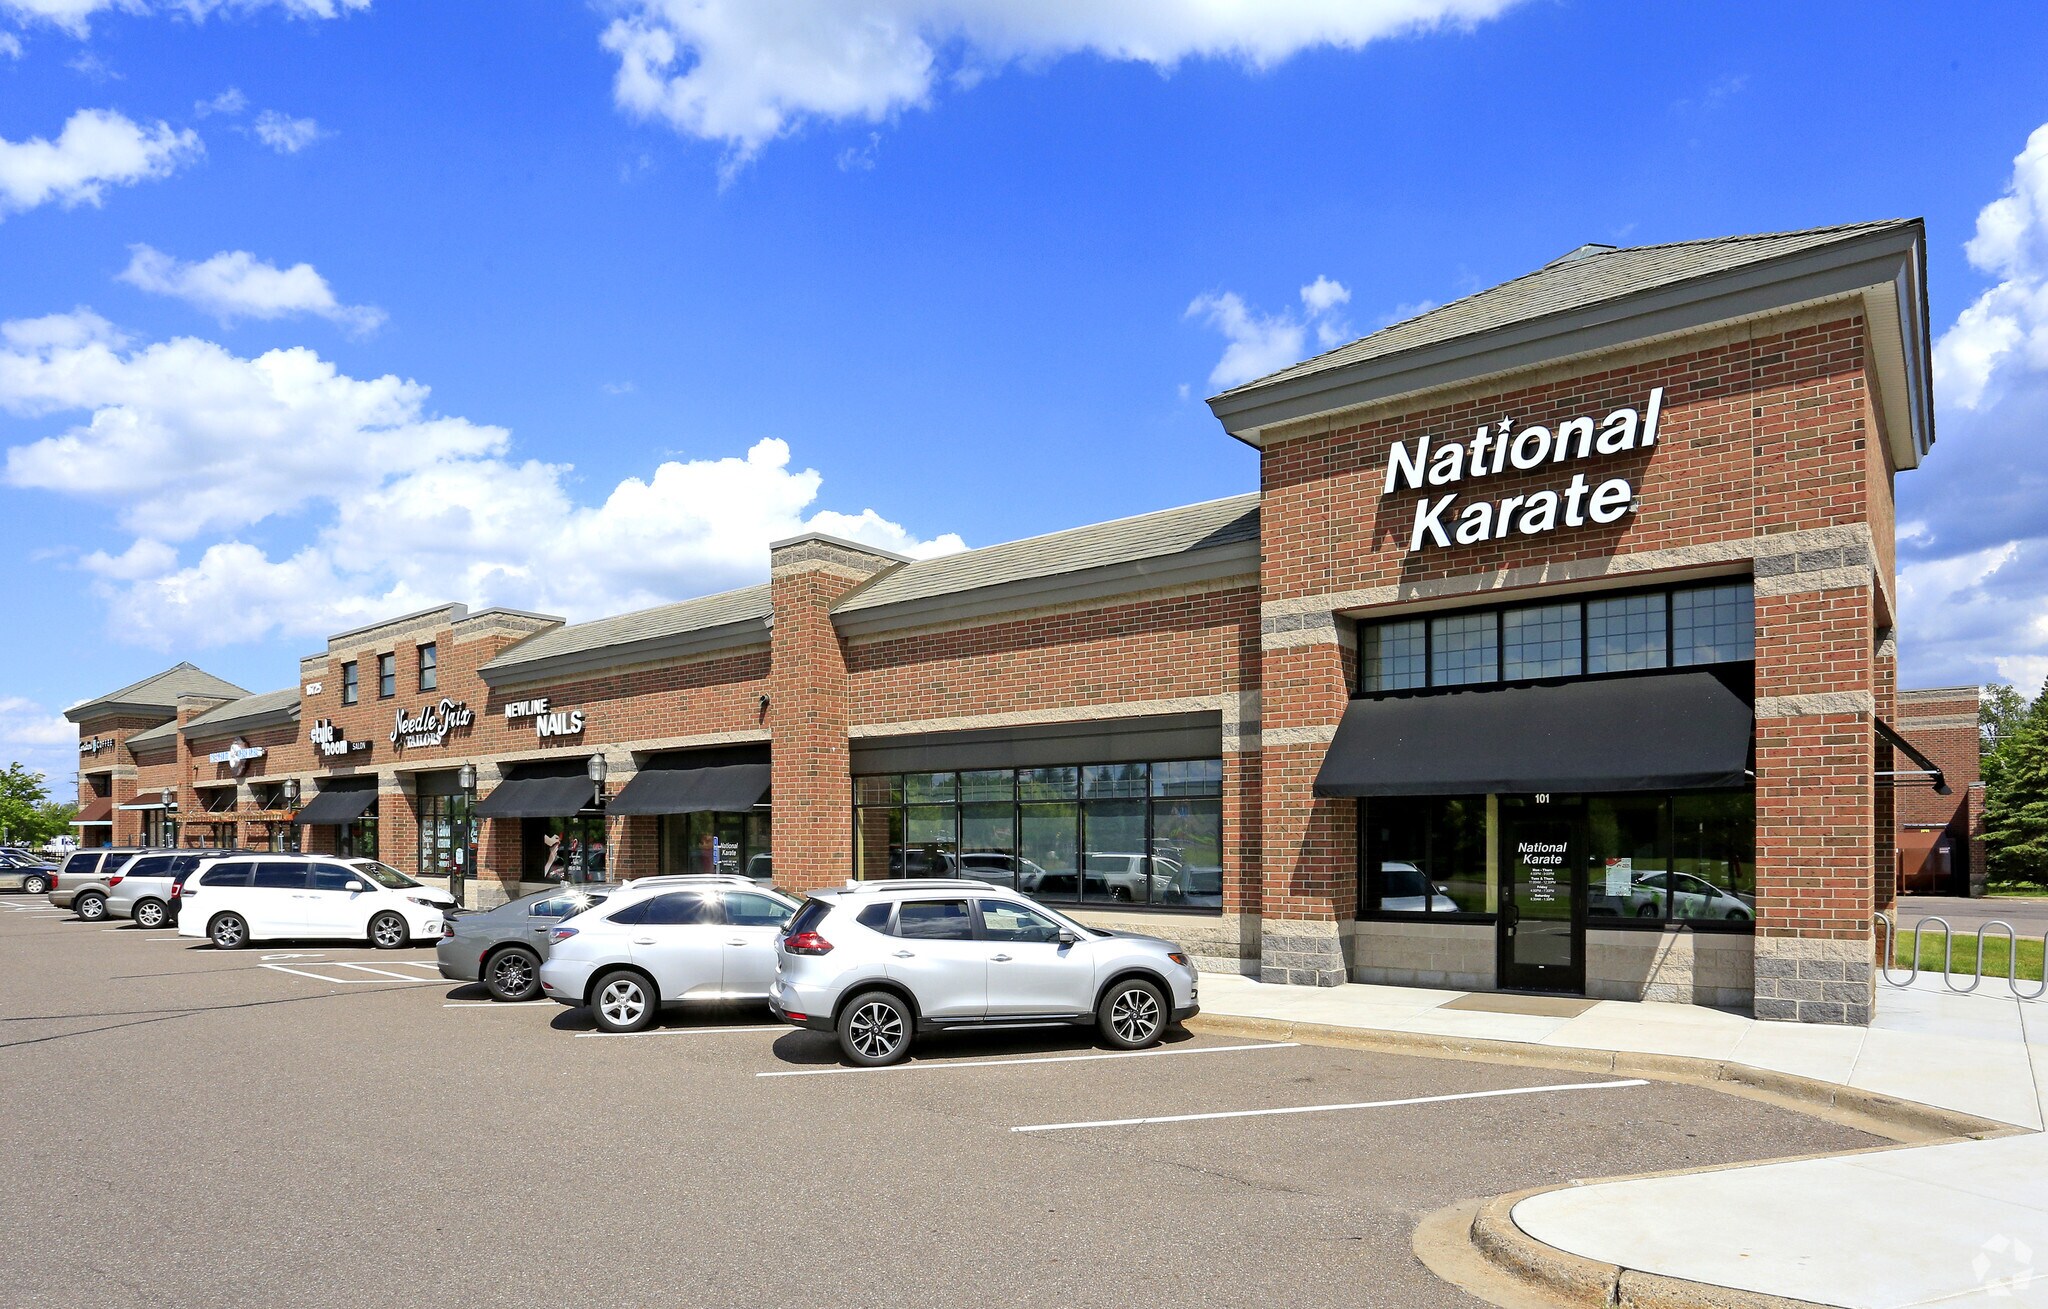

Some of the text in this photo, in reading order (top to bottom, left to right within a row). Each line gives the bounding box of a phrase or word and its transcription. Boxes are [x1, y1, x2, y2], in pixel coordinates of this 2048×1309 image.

[1383, 386, 1664, 494] National
[1409, 473, 1633, 552] Karate
[505, 698, 548, 718] NEWLINE
[390, 698, 475, 742] Needle Trix
[536, 710, 583, 737] NAILS
[352, 742, 366, 750] SALON
[406, 732, 441, 748] TAILORS
[1535, 793, 1550, 804] 101
[1518, 842, 1568, 852] National
[1523, 854, 1562, 864] Karate
